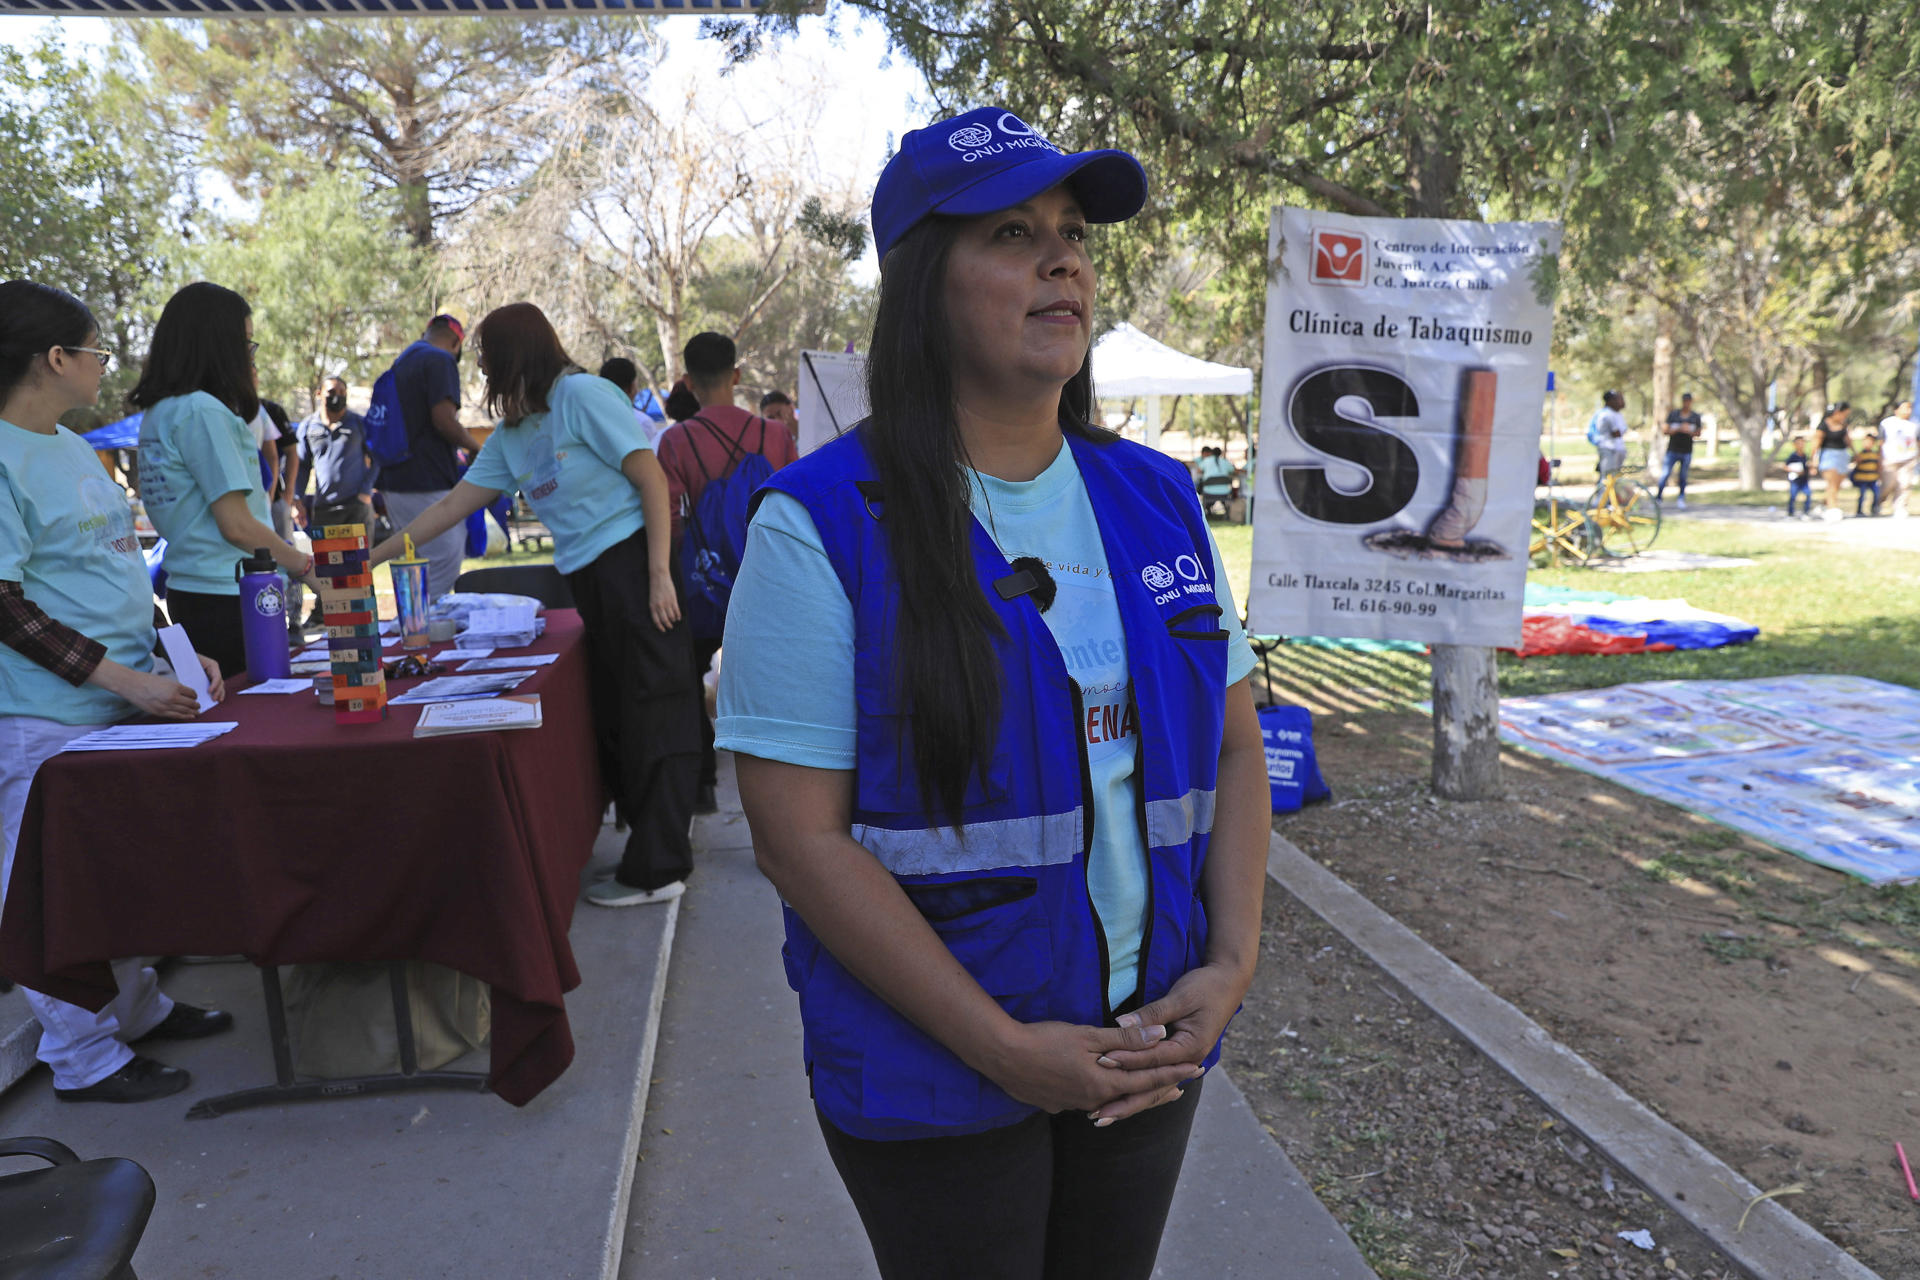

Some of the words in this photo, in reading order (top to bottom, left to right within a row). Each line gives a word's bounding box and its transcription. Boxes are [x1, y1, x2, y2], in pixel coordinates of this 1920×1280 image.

[963, 143, 1004, 162] ONU
[1374, 239, 1426, 253] Centros
[1430, 242, 1447, 254] de
[1374, 275, 1397, 288] Cd.
[1289, 309, 1364, 337] Clínica
[1373, 315, 1399, 338] de
[1408, 316, 1534, 346] Tabaquismo
[1058, 562, 1089, 575] vida
[1094, 569, 1103, 578] y
[1268, 573, 1299, 588] Calle
[1304, 574, 1360, 591] Tlaxcala
[1364, 578, 1402, 595] 3245
[1155, 588, 1181, 606] ONU
[1332, 596, 1355, 611] Tel.
[1360, 599, 1437, 617] 616-90-99
[1087, 704, 1137, 744] ENA
